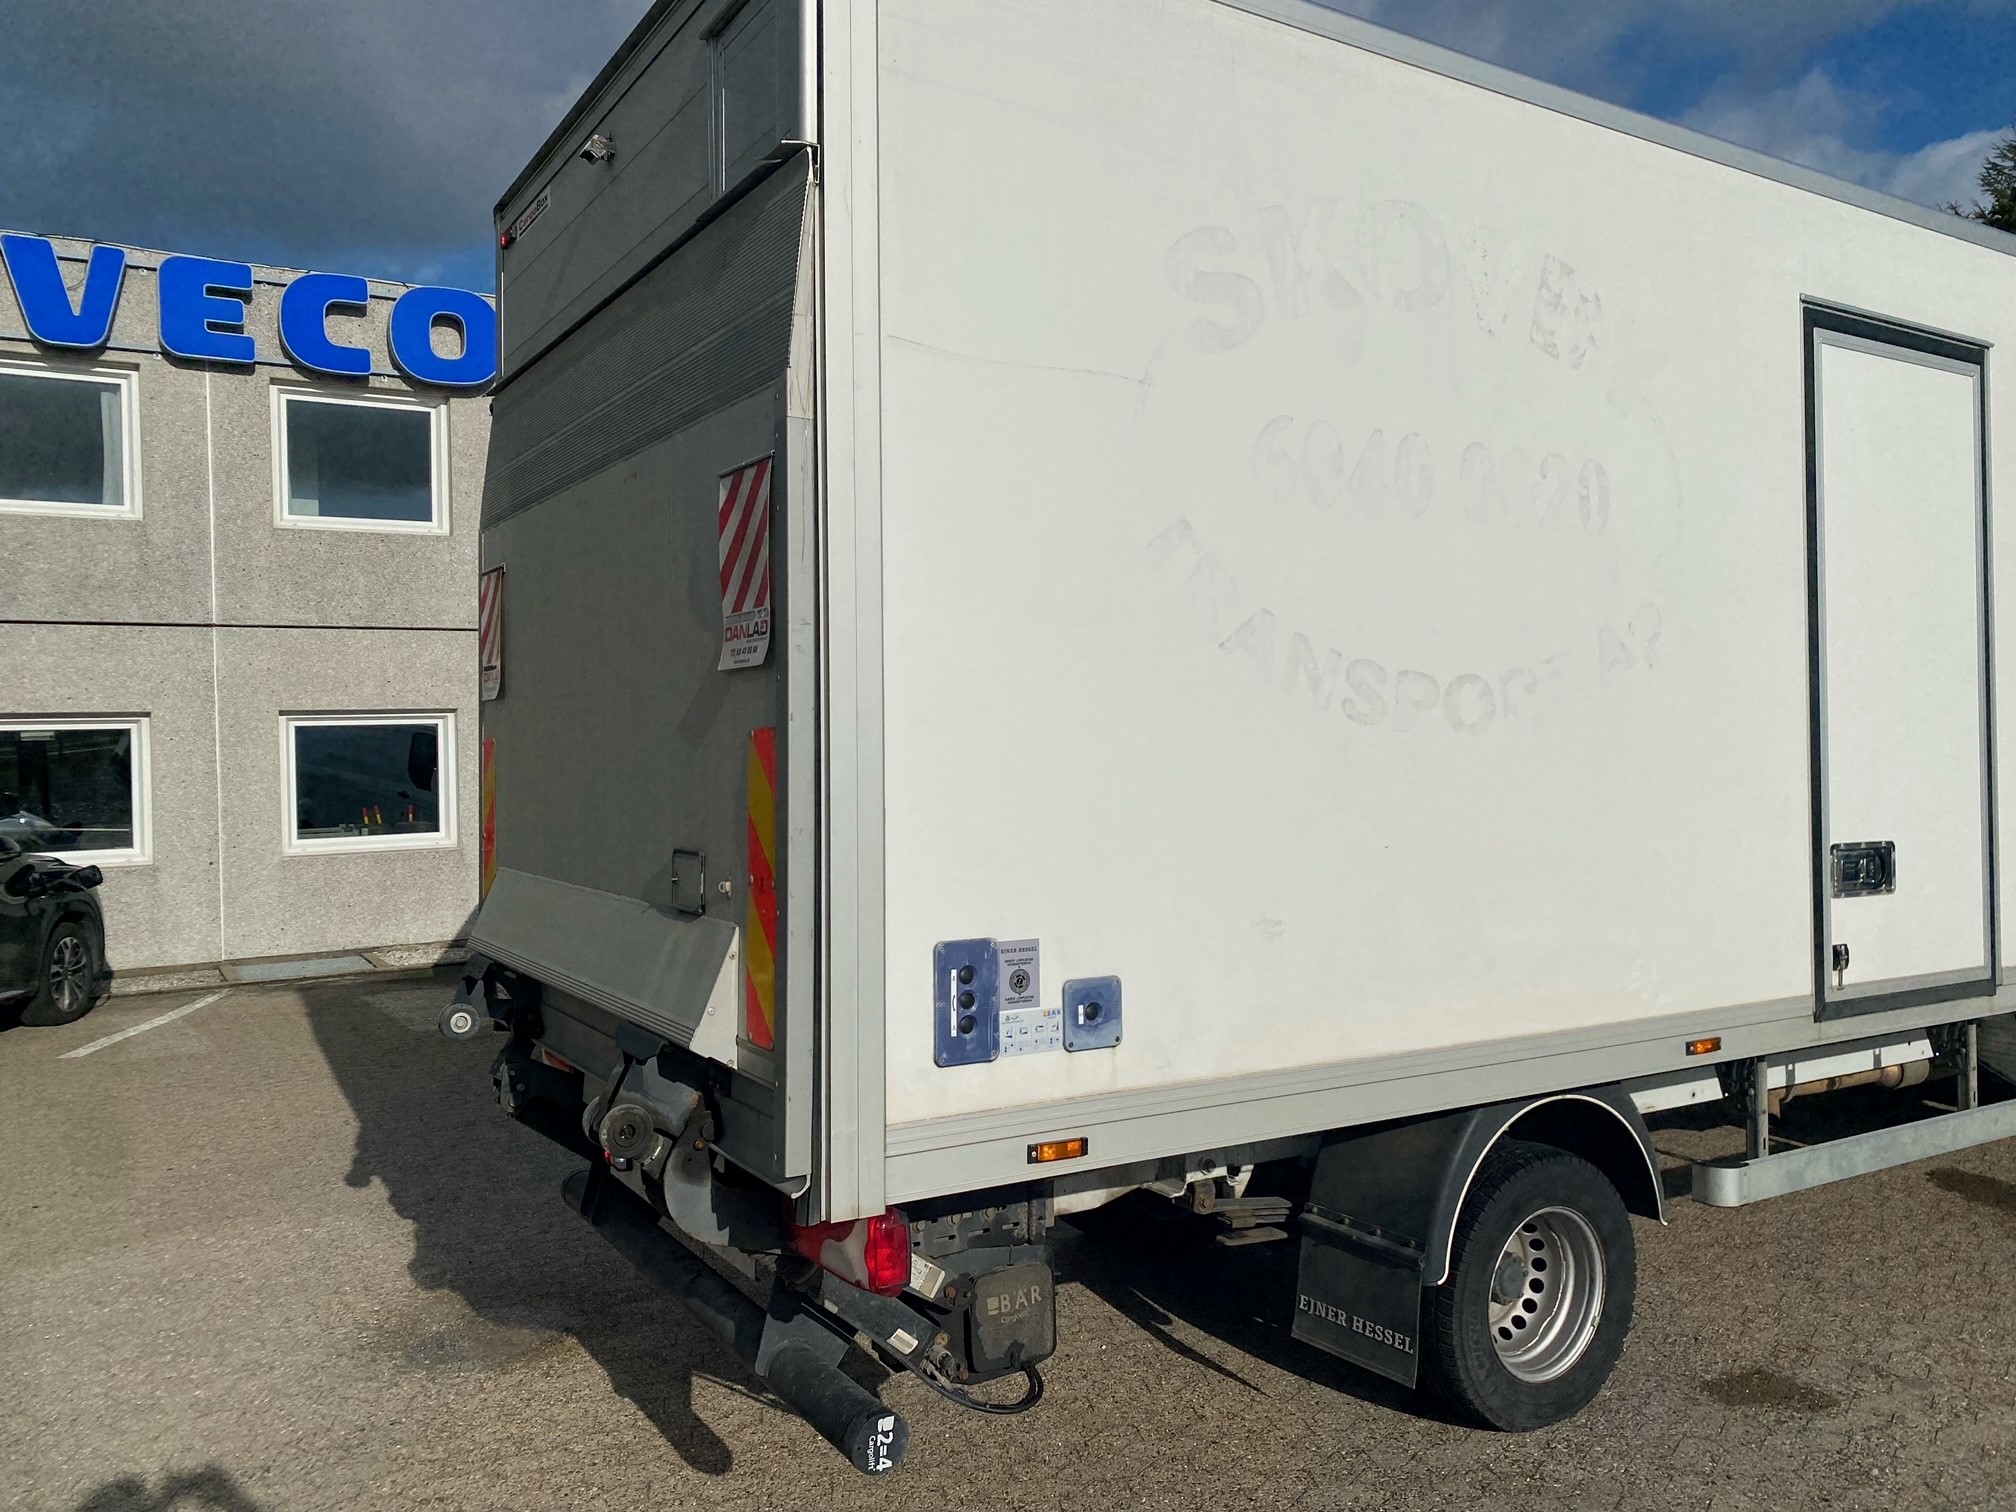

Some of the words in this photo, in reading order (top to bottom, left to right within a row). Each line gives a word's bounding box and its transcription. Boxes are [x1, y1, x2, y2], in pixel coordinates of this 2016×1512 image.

[0, 233, 496, 386] VECO
[1298, 1294, 1348, 1328] EJNER
[1351, 1315, 1414, 1355] HESSEL
